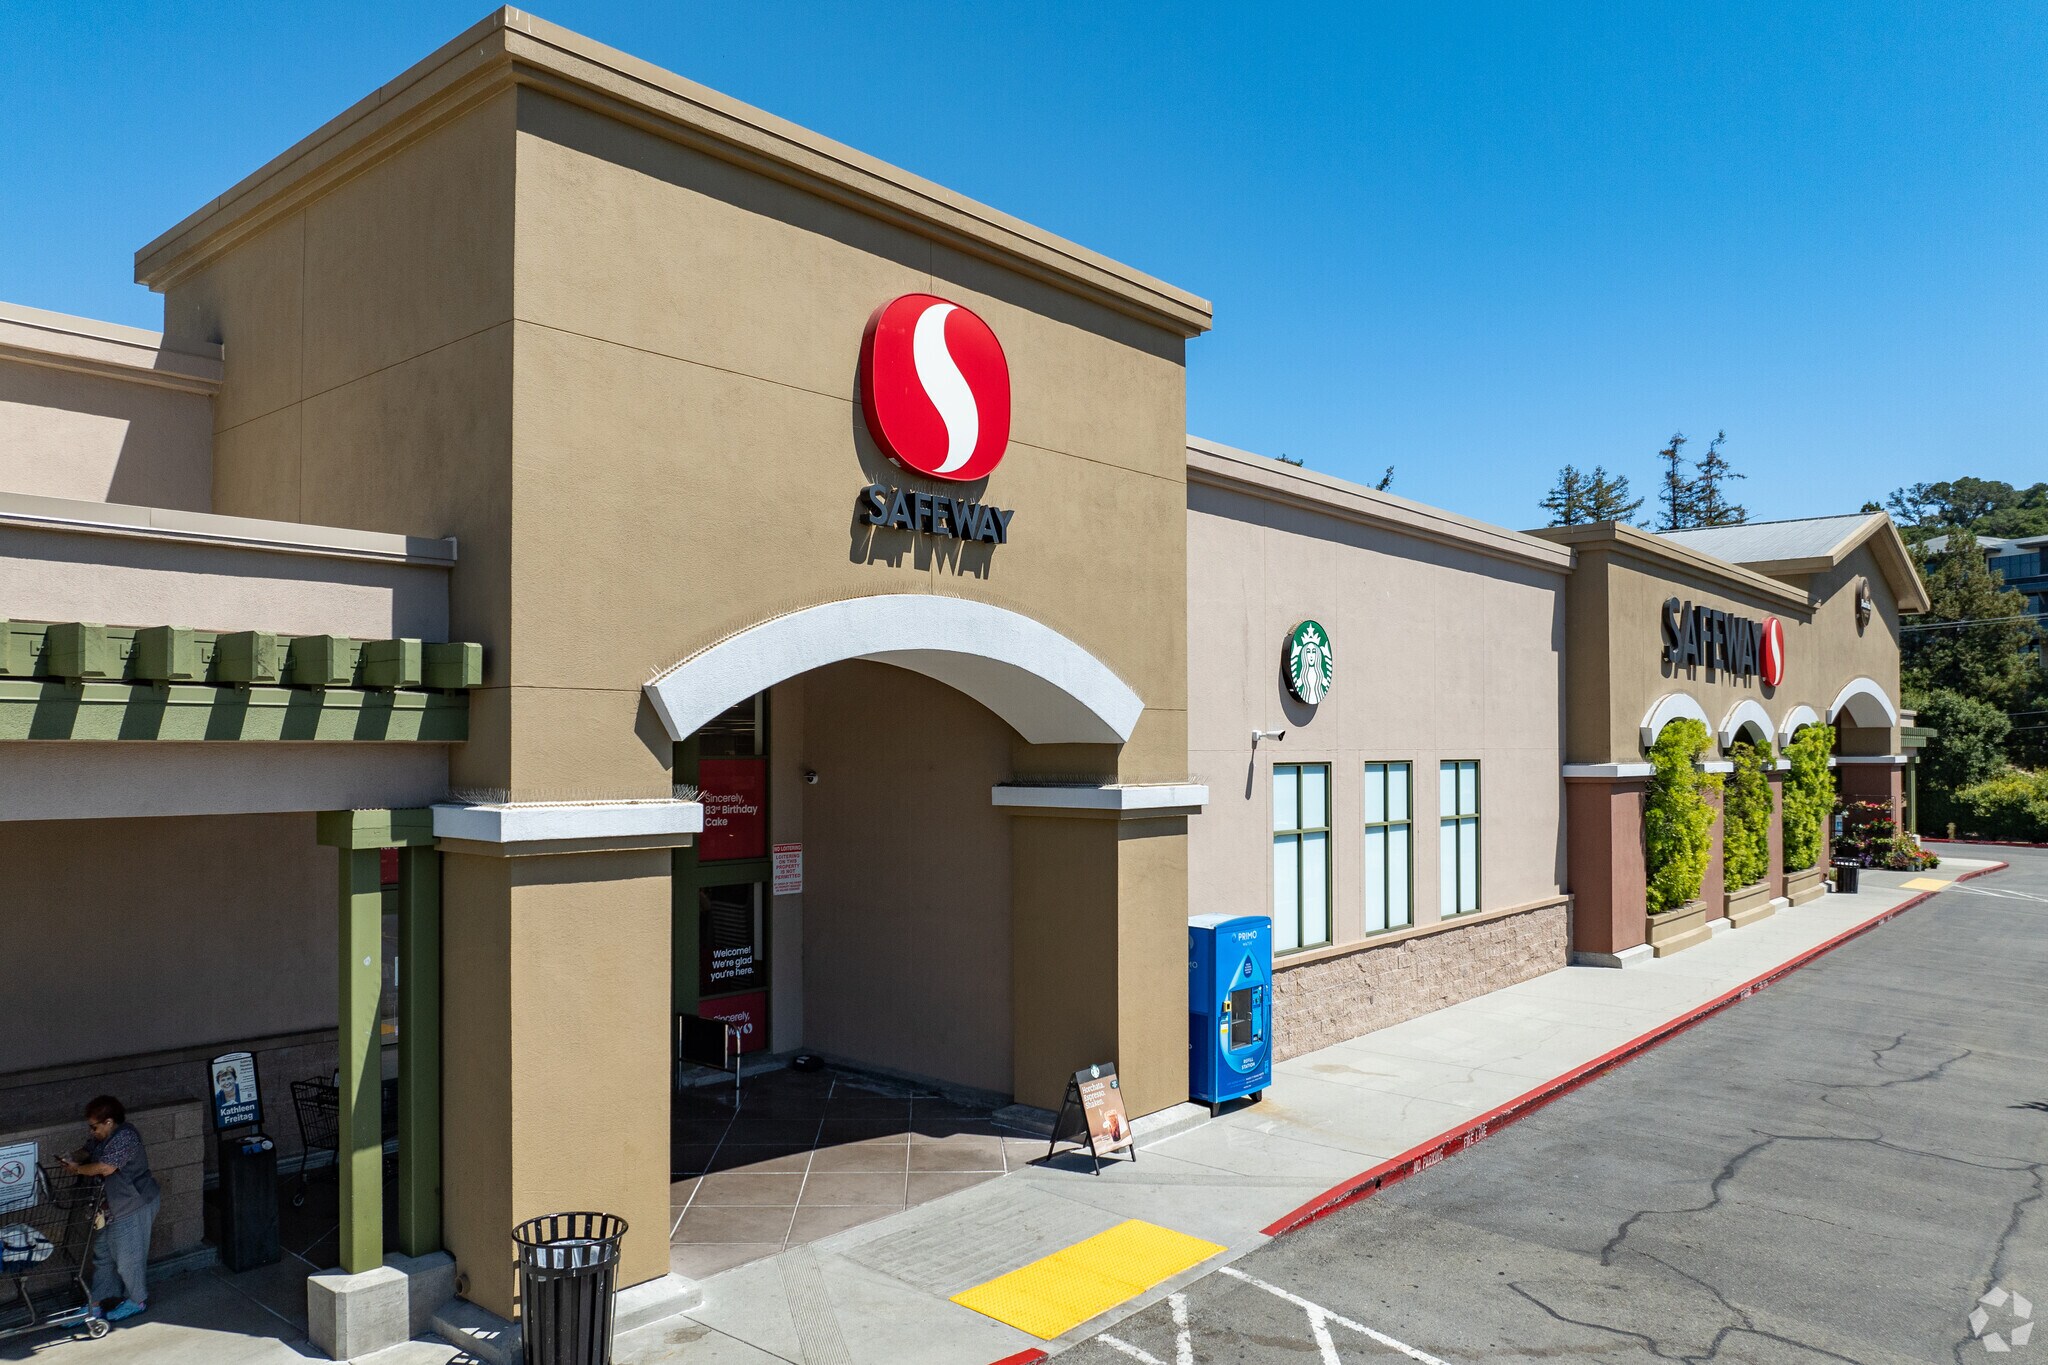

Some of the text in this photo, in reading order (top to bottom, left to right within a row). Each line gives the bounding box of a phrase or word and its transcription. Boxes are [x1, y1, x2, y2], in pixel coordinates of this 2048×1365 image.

[862, 483, 1015, 544] SAFEWAY
[1661, 597, 1763, 676] SAFEWAY
[705, 792, 745, 804] Sincerely,
[722, 804, 758, 816] Birthday
[705, 817, 728, 827] Cake
[1238, 930, 1257, 941] PRIMO
[713, 946, 751, 958] Welcome!
[712, 956, 752, 969] We're glad
[710, 967, 754, 982] you're here.
[220, 1104, 255, 1116] Kathleen
[224, 1112, 253, 1124] Freitag
[1413, 1159, 1421, 1174] NO
